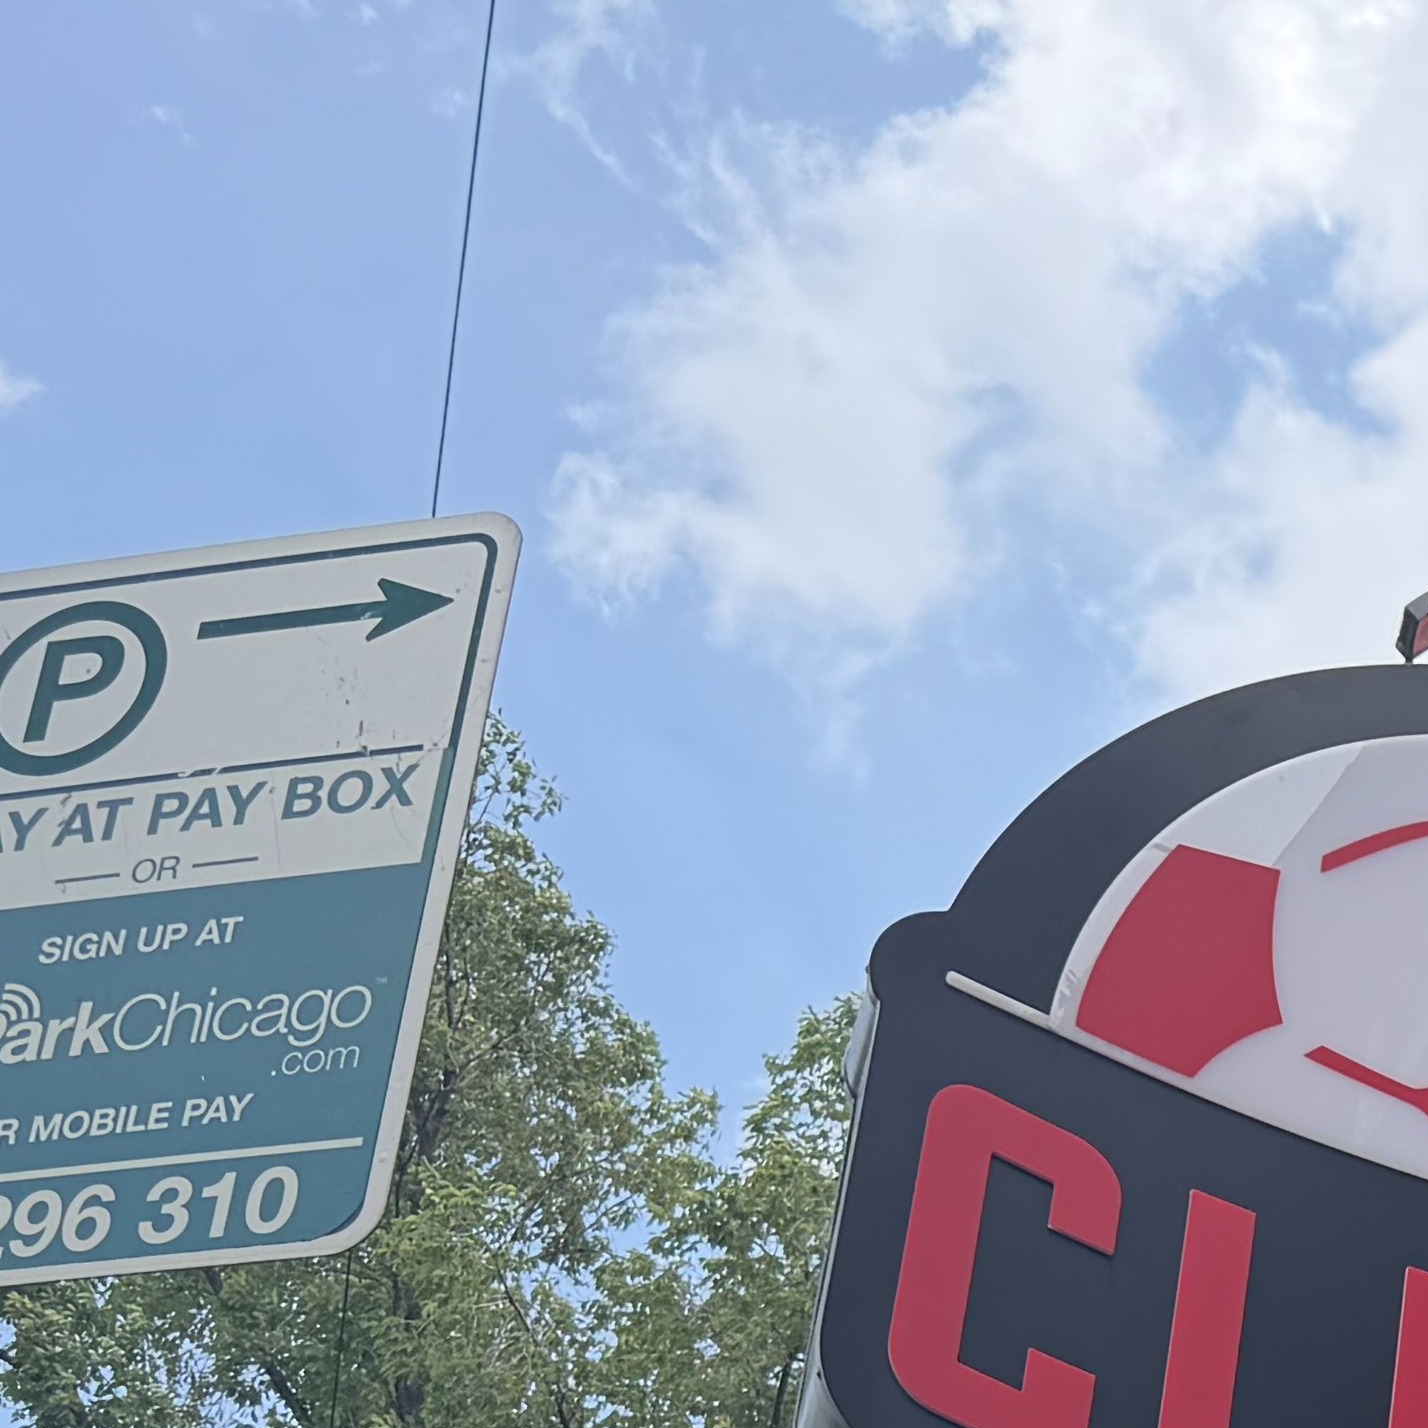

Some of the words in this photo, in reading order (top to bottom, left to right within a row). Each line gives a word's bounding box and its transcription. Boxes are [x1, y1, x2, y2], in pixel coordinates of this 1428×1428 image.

[0, 807, 48, 853] Y
[51, 796, 134, 848] AT
[146, 780, 268, 836] PAY
[281, 763, 420, 822] BOX
[131, 856, 181, 884] OR
[38, 929, 126, 965] SIGN
[137, 921, 189, 954] UP
[195, 915, 244, 947] AT
[270, 1045, 361, 1077] .com
[29, 1104, 173, 1144] MOBILE
[182, 1092, 254, 1127] PAY
[138, 1165, 299, 1245] 310
